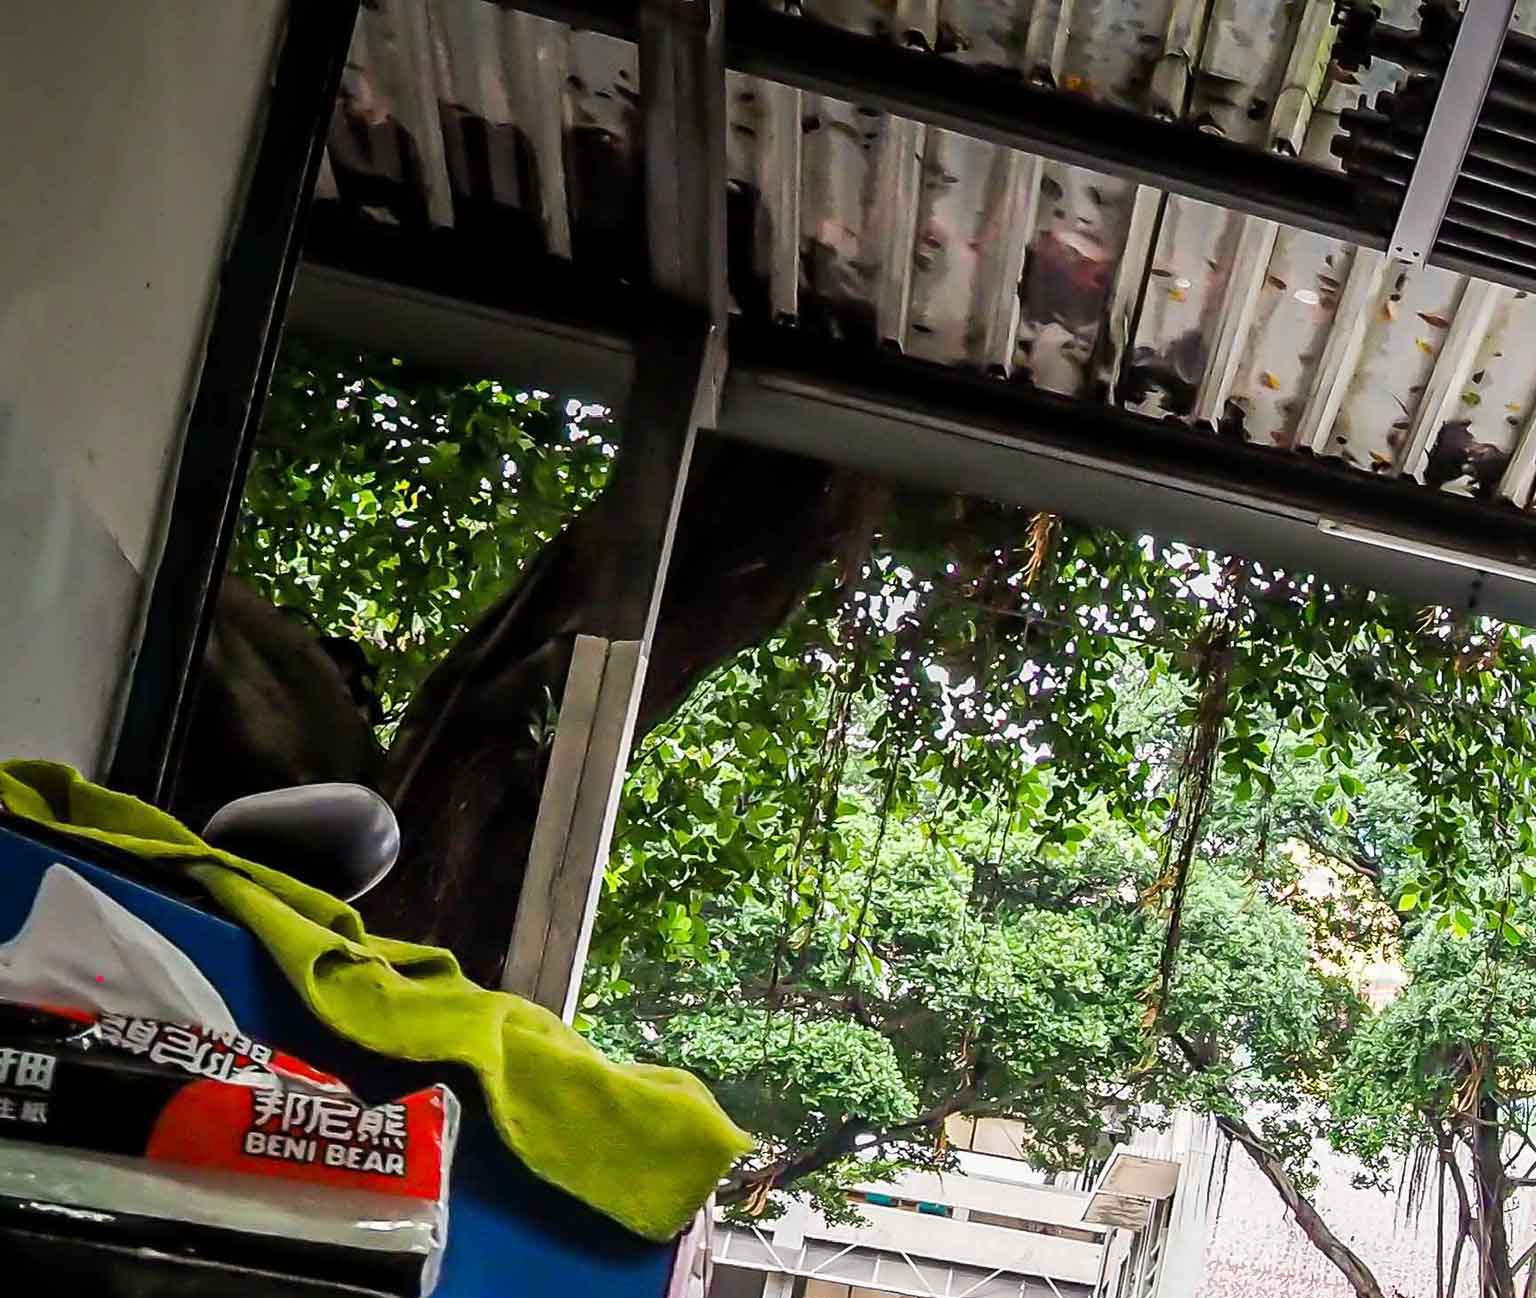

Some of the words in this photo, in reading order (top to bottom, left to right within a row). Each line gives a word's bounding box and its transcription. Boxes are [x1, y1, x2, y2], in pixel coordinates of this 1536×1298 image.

[253, 1088, 407, 1149] 邦尼熊
[245, 1131, 316, 1162] BENI
[324, 1144, 406, 1176] BEAR
